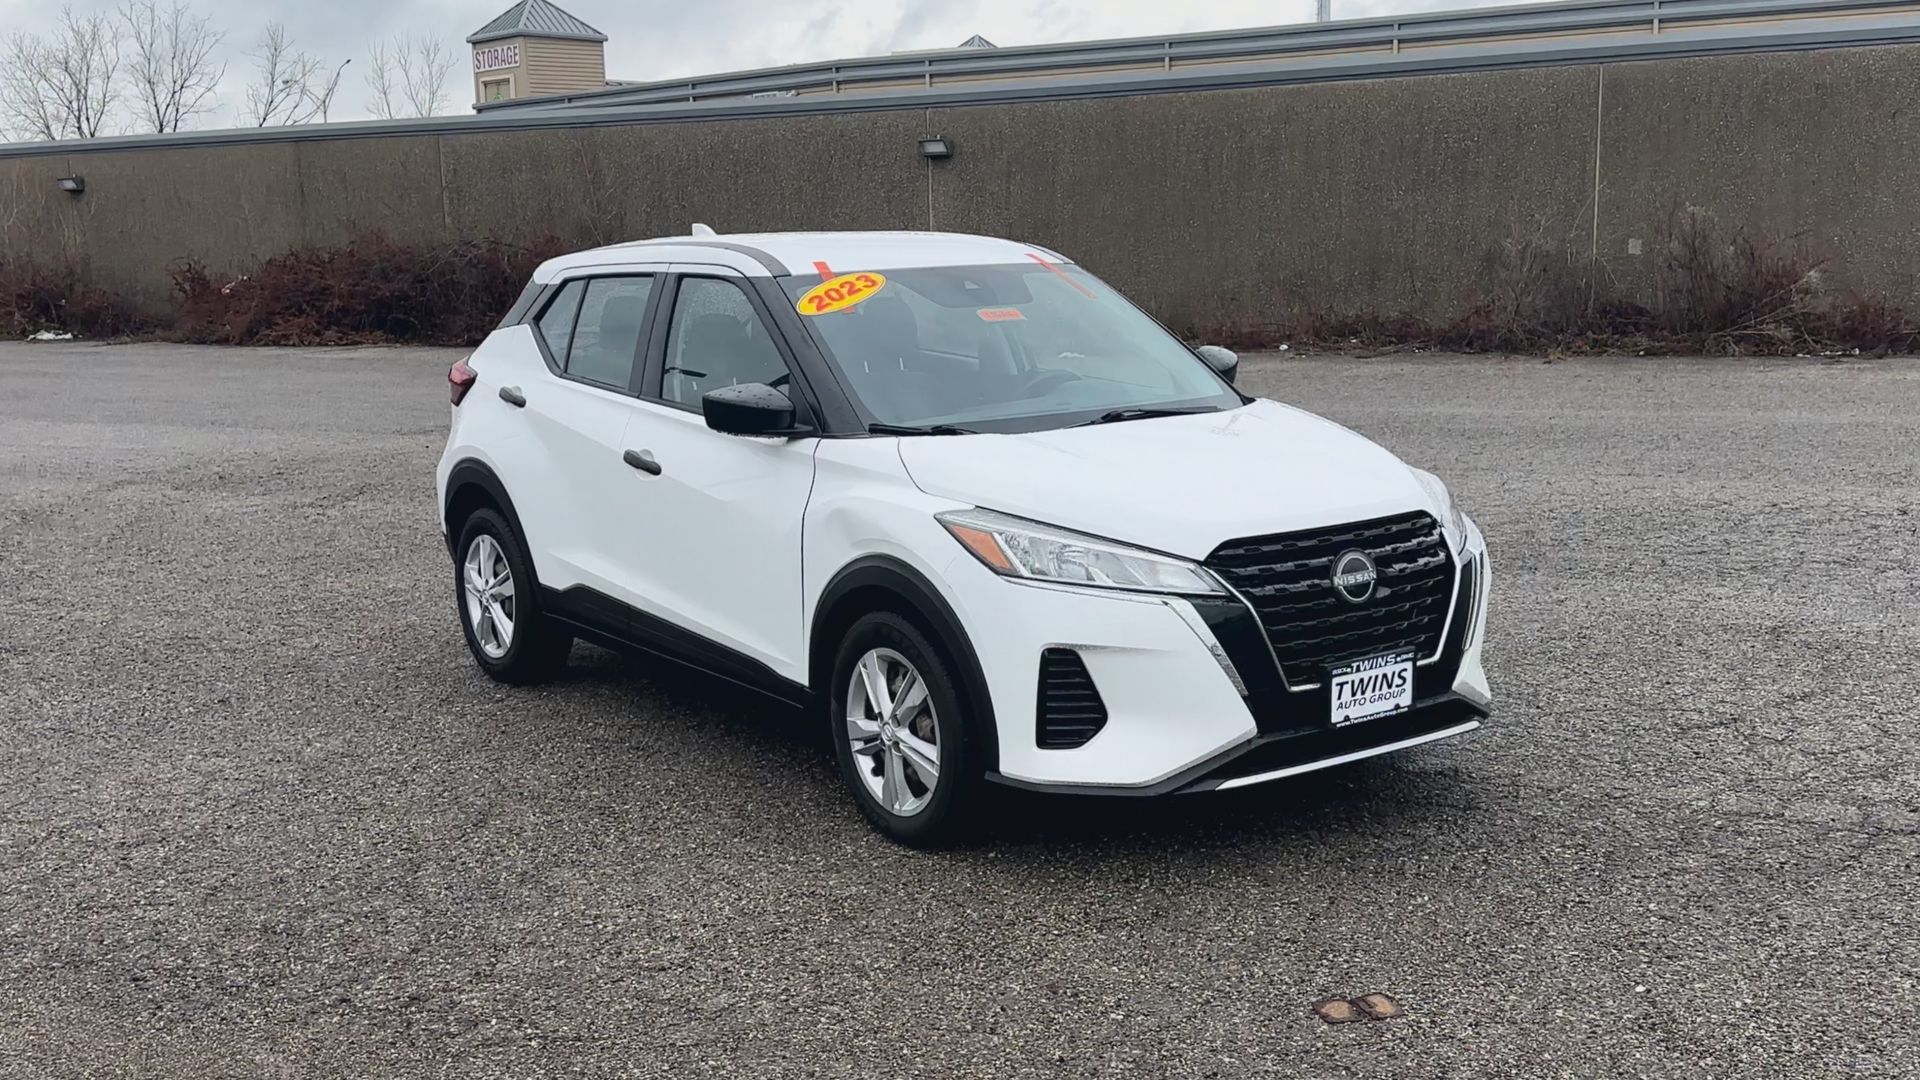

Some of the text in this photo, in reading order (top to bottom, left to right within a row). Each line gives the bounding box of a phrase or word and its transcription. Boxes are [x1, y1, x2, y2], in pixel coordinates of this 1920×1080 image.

[475, 46, 519, 70] STORAGE
[808, 275, 877, 312] 2023
[1333, 571, 1376, 586] NISSAN
[1351, 654, 1396, 673] TWINS
[1335, 668, 1408, 701] TWINS
[1336, 688, 1406, 711] AUTO GROUP
